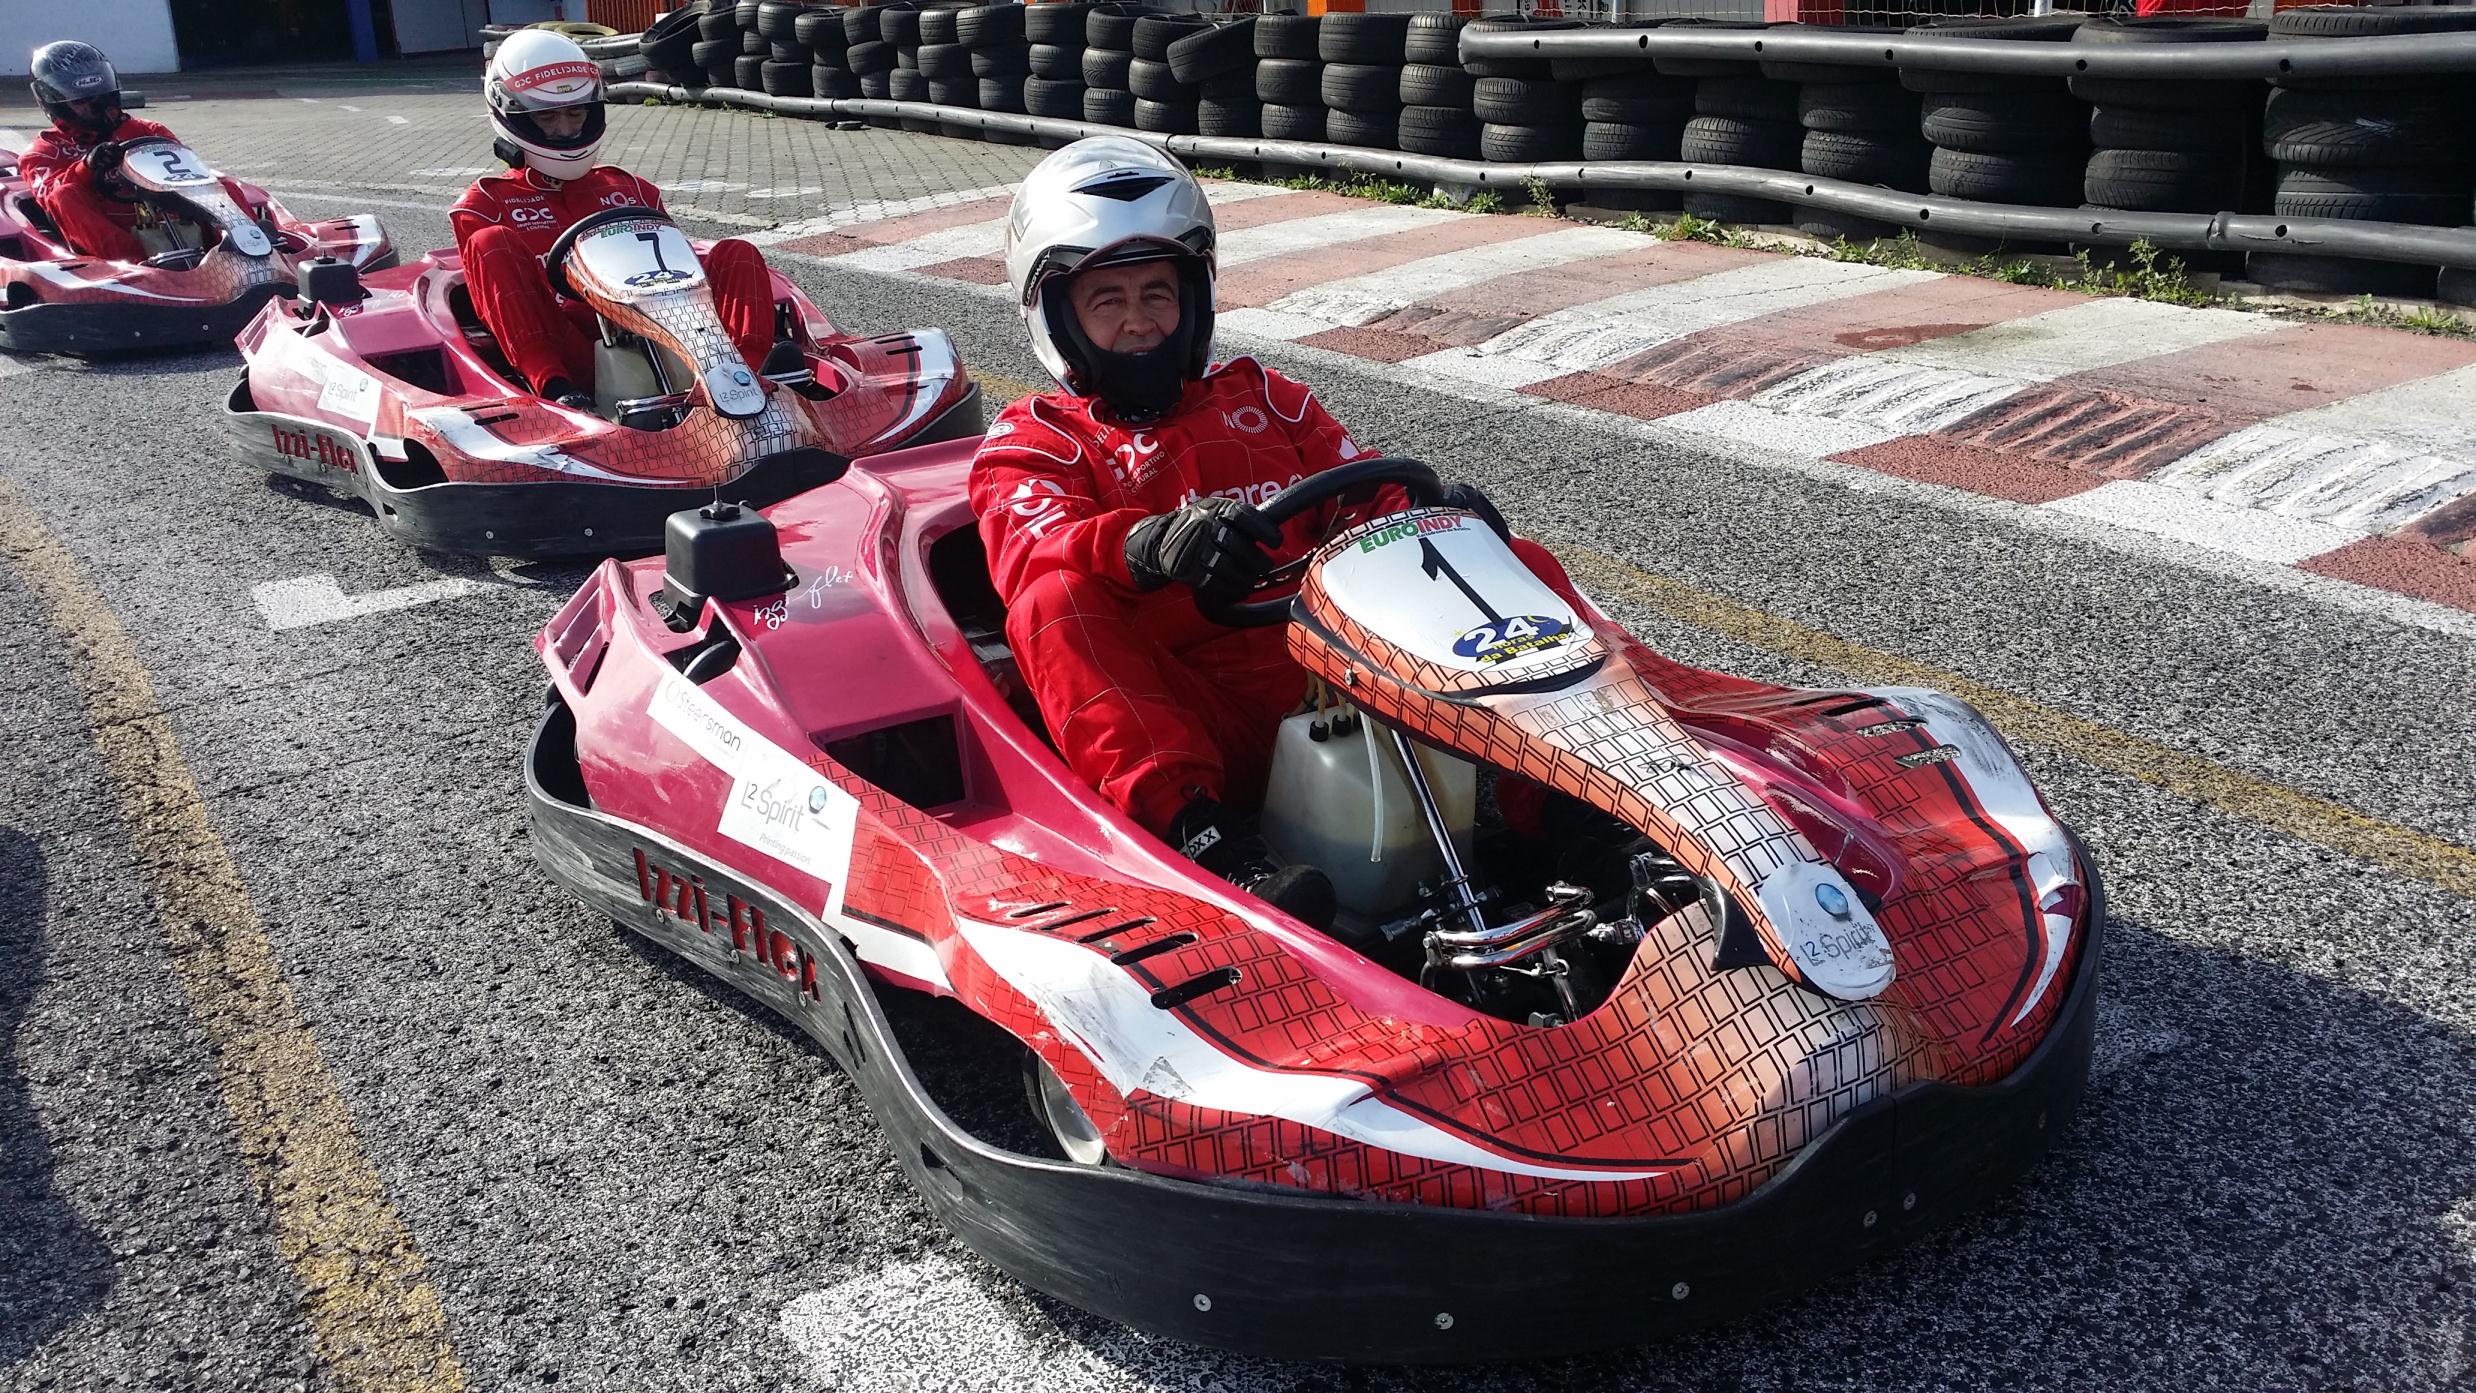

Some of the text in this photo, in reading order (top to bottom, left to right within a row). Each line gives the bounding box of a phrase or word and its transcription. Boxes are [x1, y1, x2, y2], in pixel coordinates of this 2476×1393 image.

[534, 65, 588, 81] FIDELIDADE
[153, 150, 192, 174] 2
[600, 191, 637, 208] NOS
[600, 222, 664, 239] EUROINDY
[635, 232, 668, 272] 7
[1025, 248, 1051, 305] LONGWAY
[1360, 515, 1462, 554] EUROINDY
[1418, 536, 1504, 627] 1
[1463, 616, 1540, 653] 24
[1481, 632, 1569, 663] da Batalha
[1491, 633, 1536, 650] horas
[677, 691, 741, 752] Steersman
[759, 832, 811, 865] Printing passion
